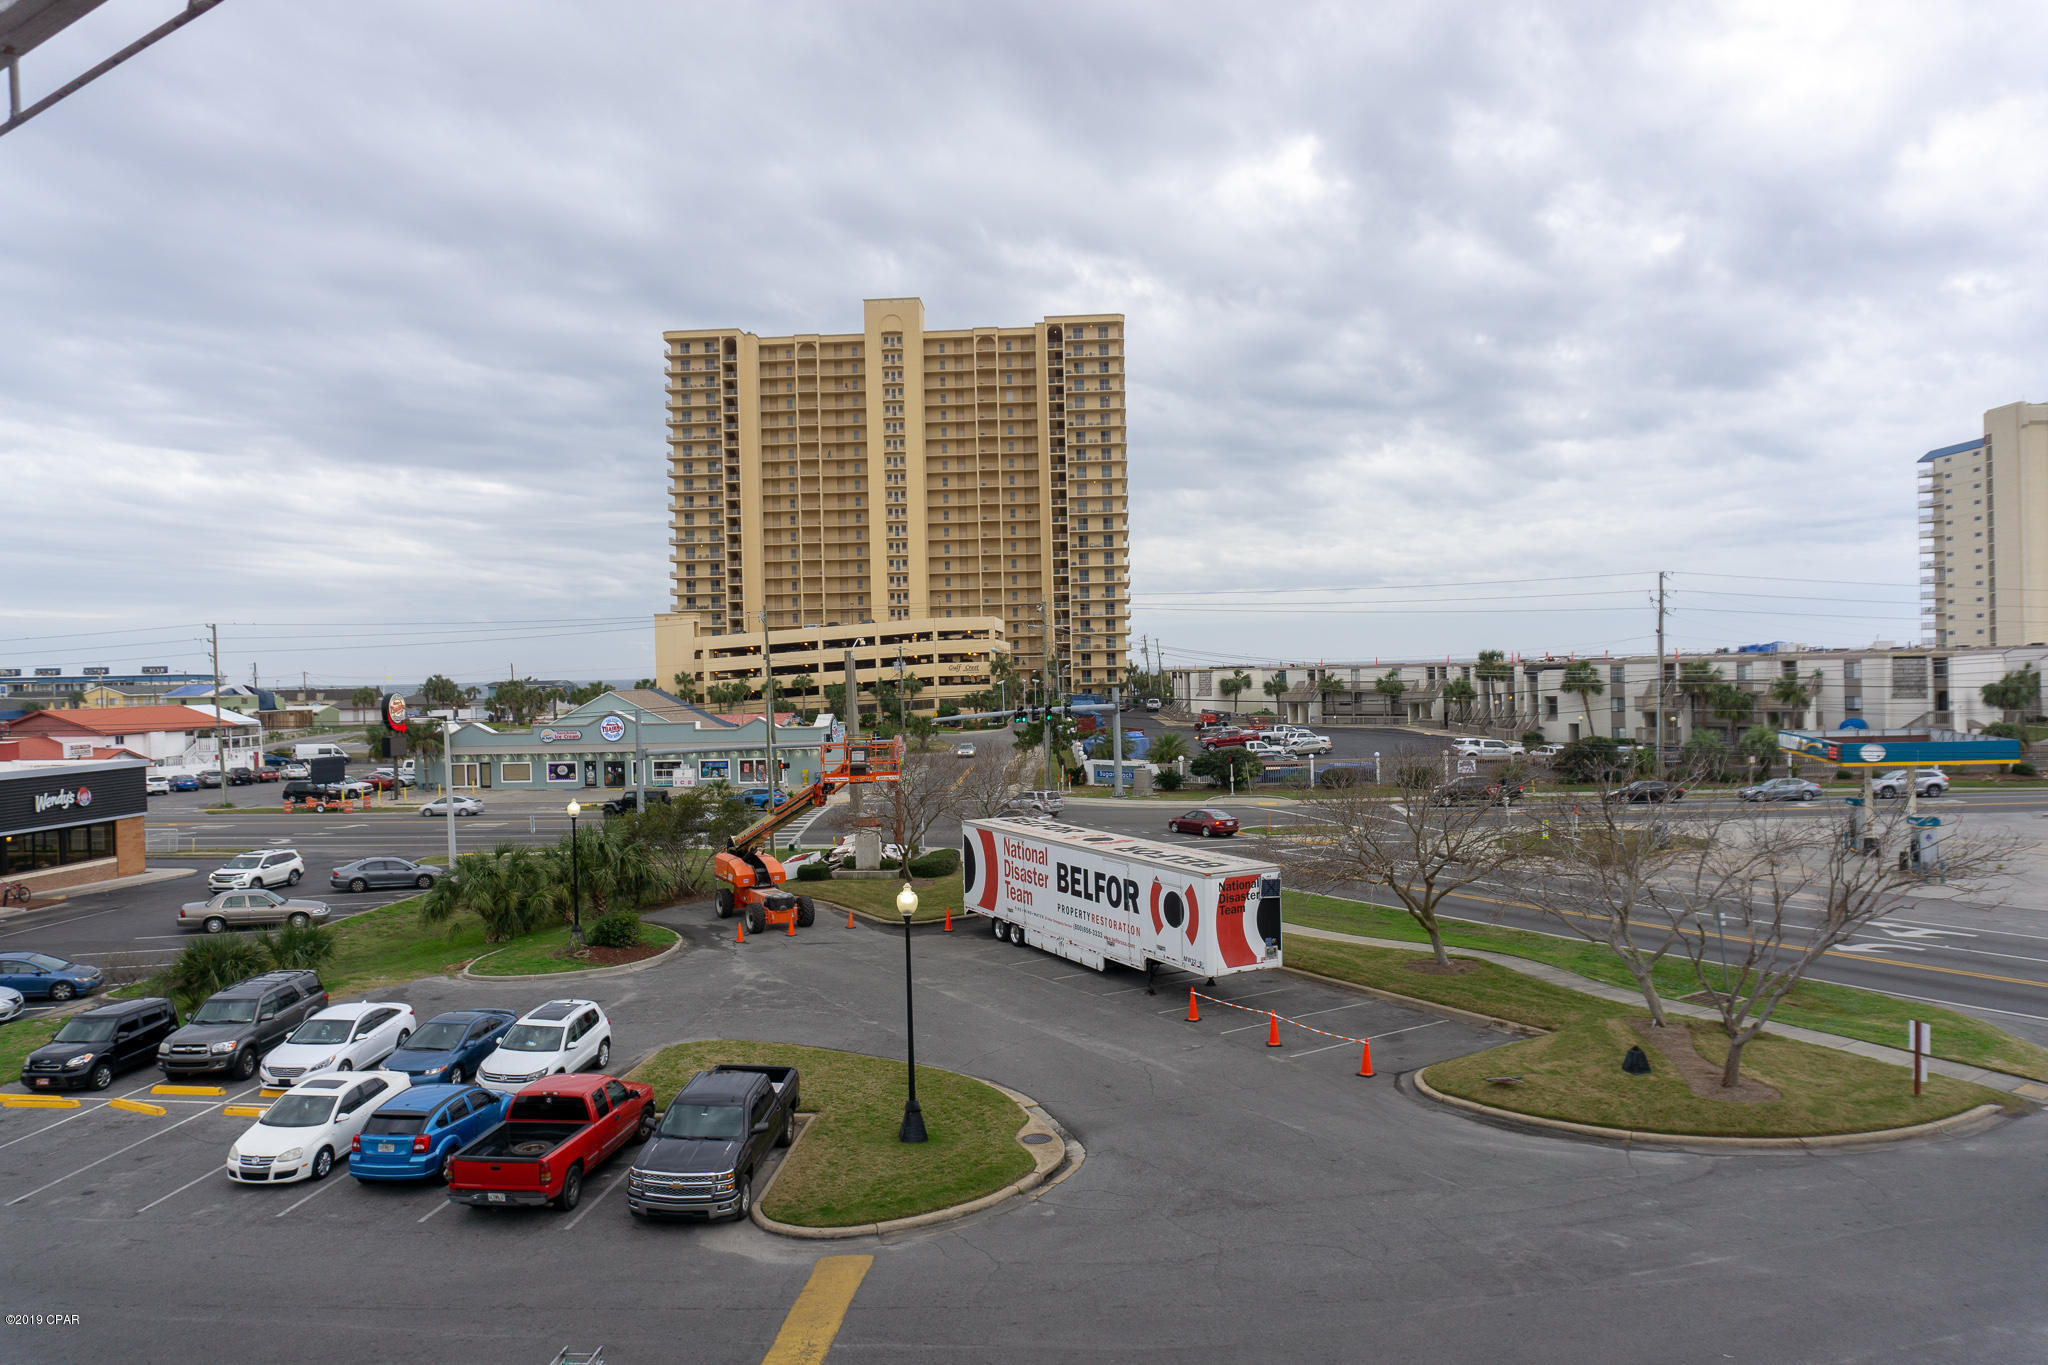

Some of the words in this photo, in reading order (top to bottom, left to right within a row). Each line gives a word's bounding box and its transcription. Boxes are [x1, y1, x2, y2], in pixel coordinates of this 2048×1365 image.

[948, 664, 962, 673] Gulf
[35, 788, 76, 813] Wendy's
[1003, 837, 1048, 866] National
[1004, 859, 1049, 888] Disaster
[1218, 877, 1260, 892] National
[1005, 880, 1033, 906] Team
[1056, 862, 1140, 915] BELFOR
[1219, 891, 1260, 904] Disaster
[1219, 904, 1246, 916] Team
